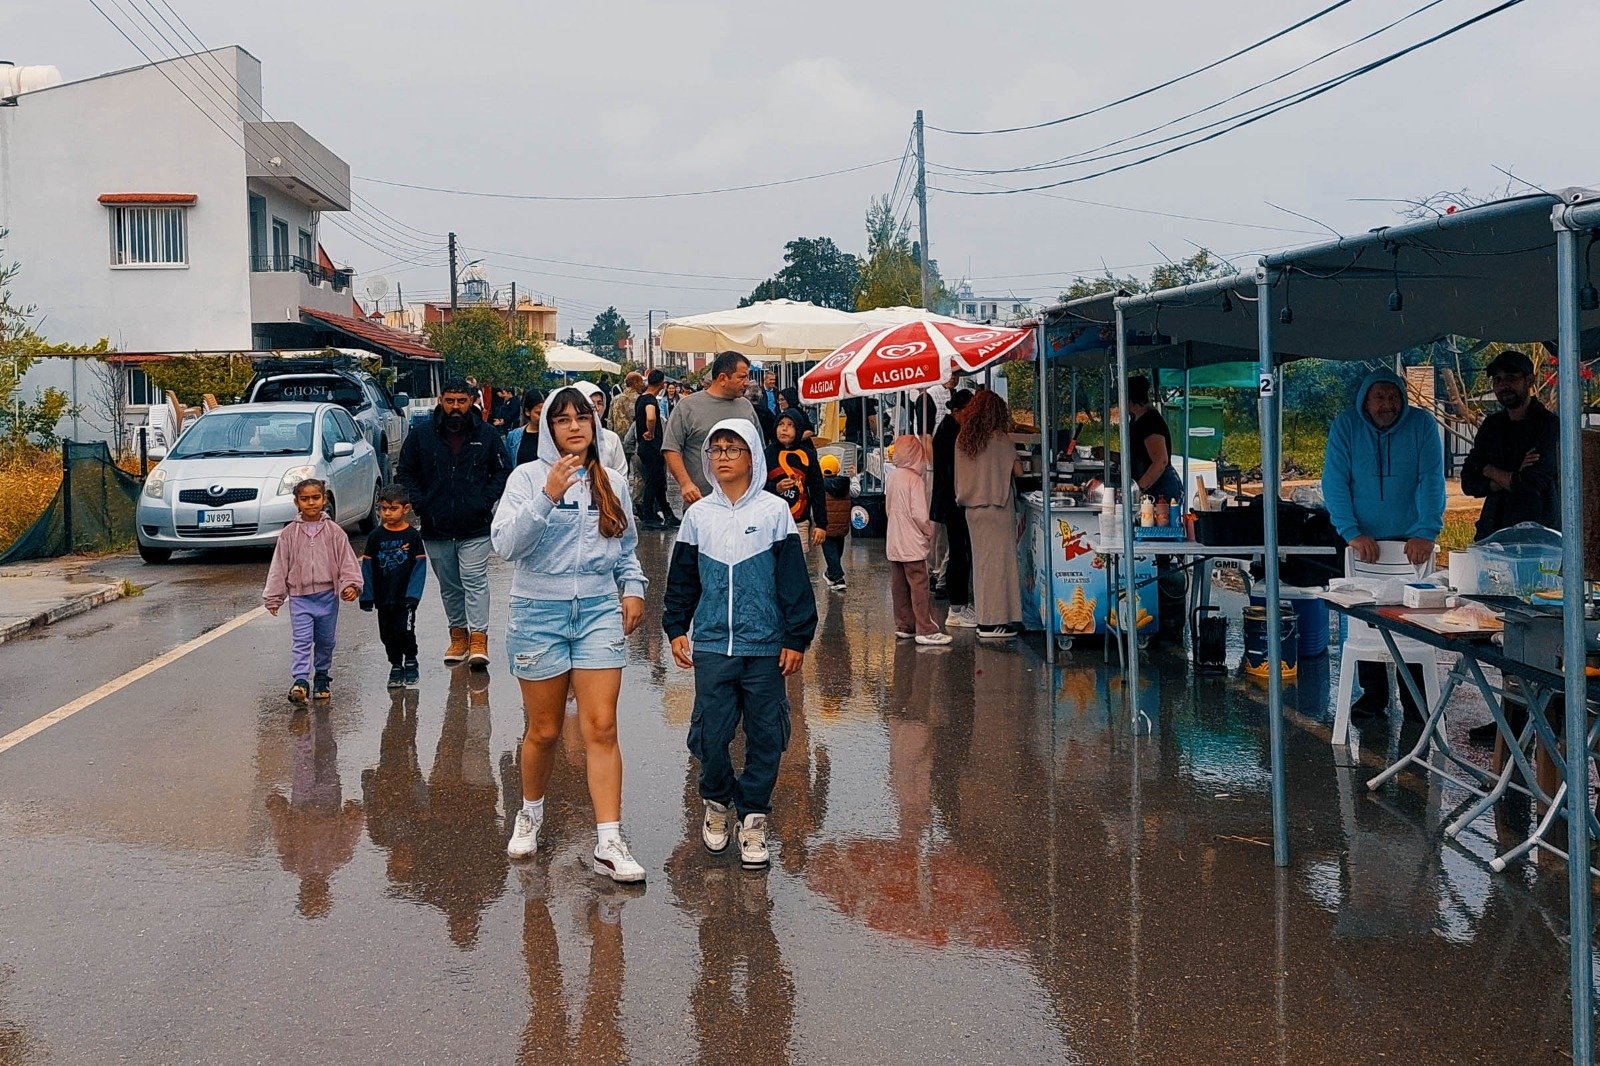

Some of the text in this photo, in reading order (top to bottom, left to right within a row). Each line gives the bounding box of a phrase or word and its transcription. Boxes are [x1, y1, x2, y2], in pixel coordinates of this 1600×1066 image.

[1260, 378, 1272, 392] 2
[283, 386, 328, 397] GHOST
[216, 513, 231, 523] 892
[1214, 560, 1238, 569] GMB
